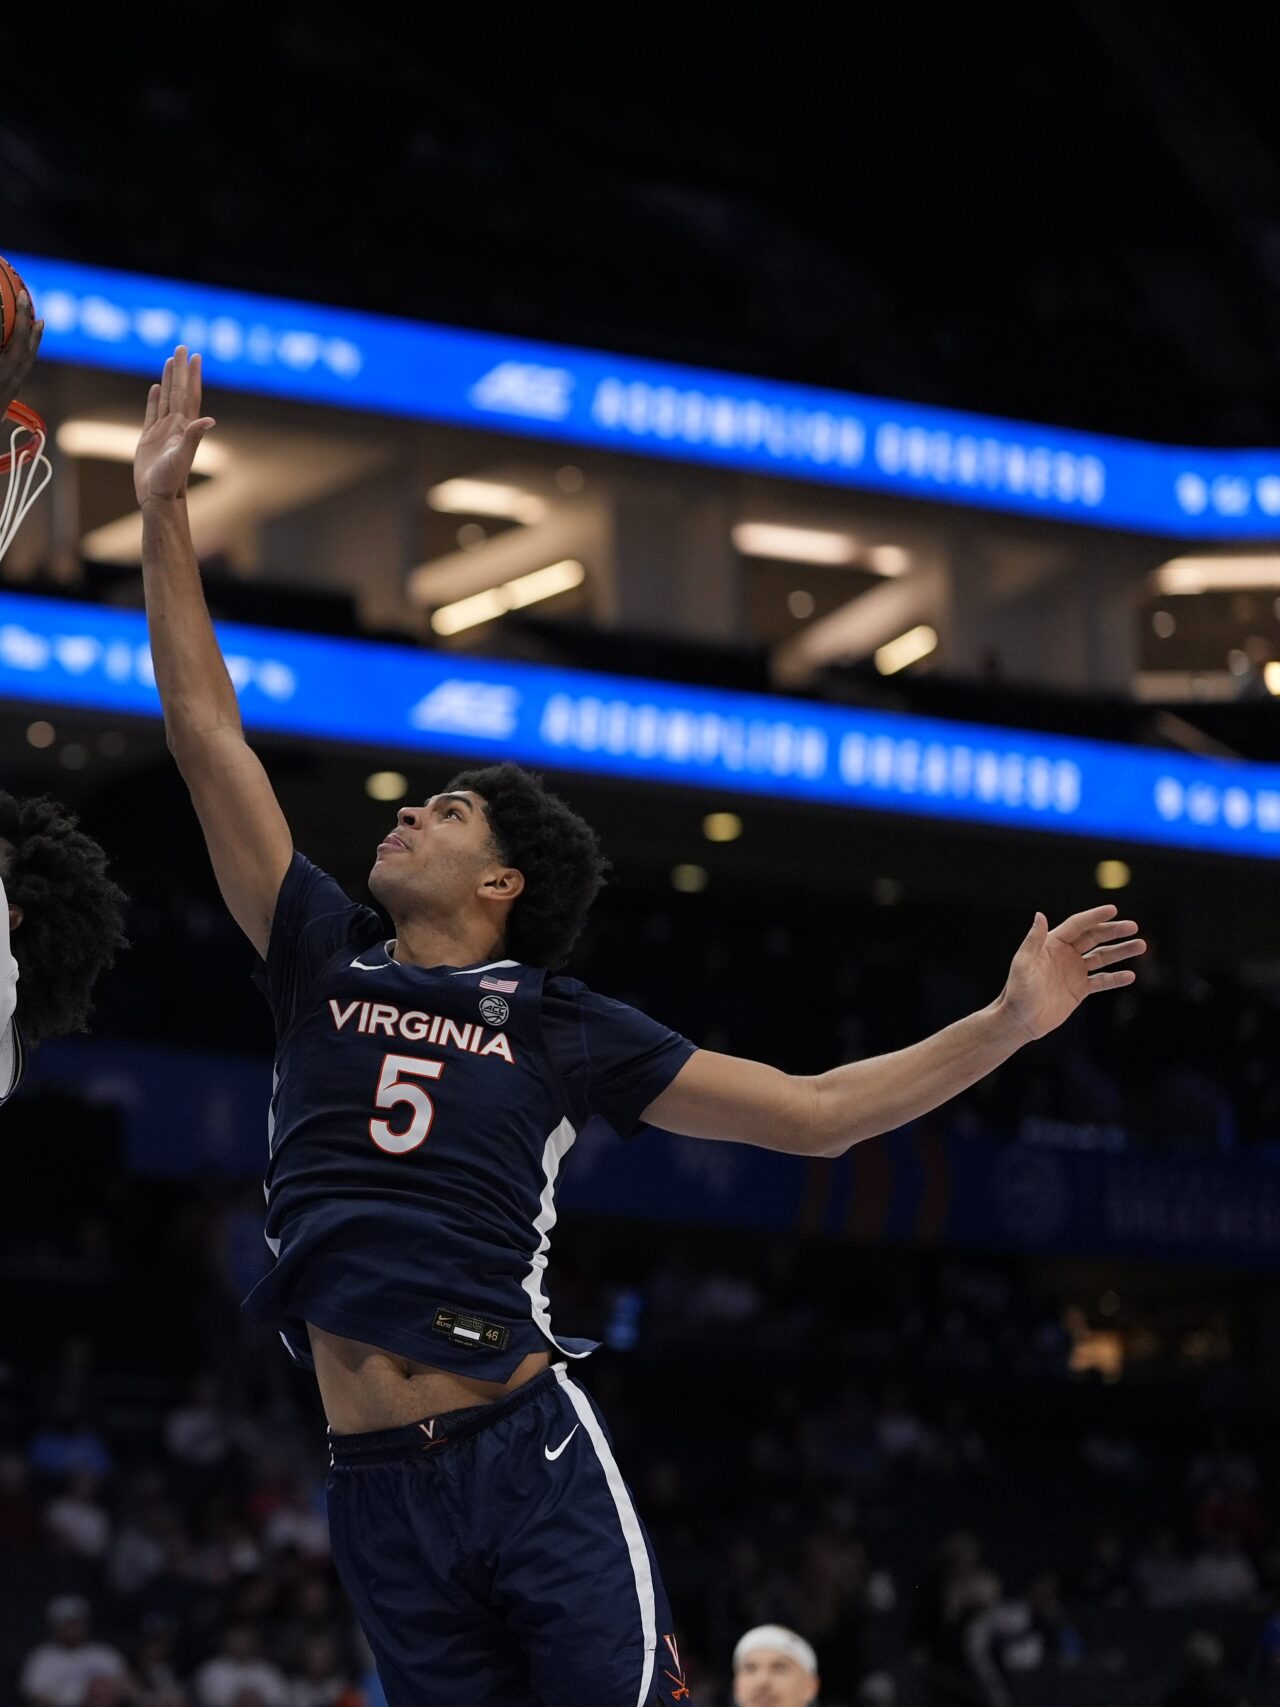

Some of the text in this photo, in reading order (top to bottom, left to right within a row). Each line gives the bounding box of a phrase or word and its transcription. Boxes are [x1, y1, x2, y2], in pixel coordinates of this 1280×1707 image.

[328, 999, 516, 1064] VIRGINIA
[370, 1053, 445, 1155] 5
[485, 1329, 499, 1341] 46
